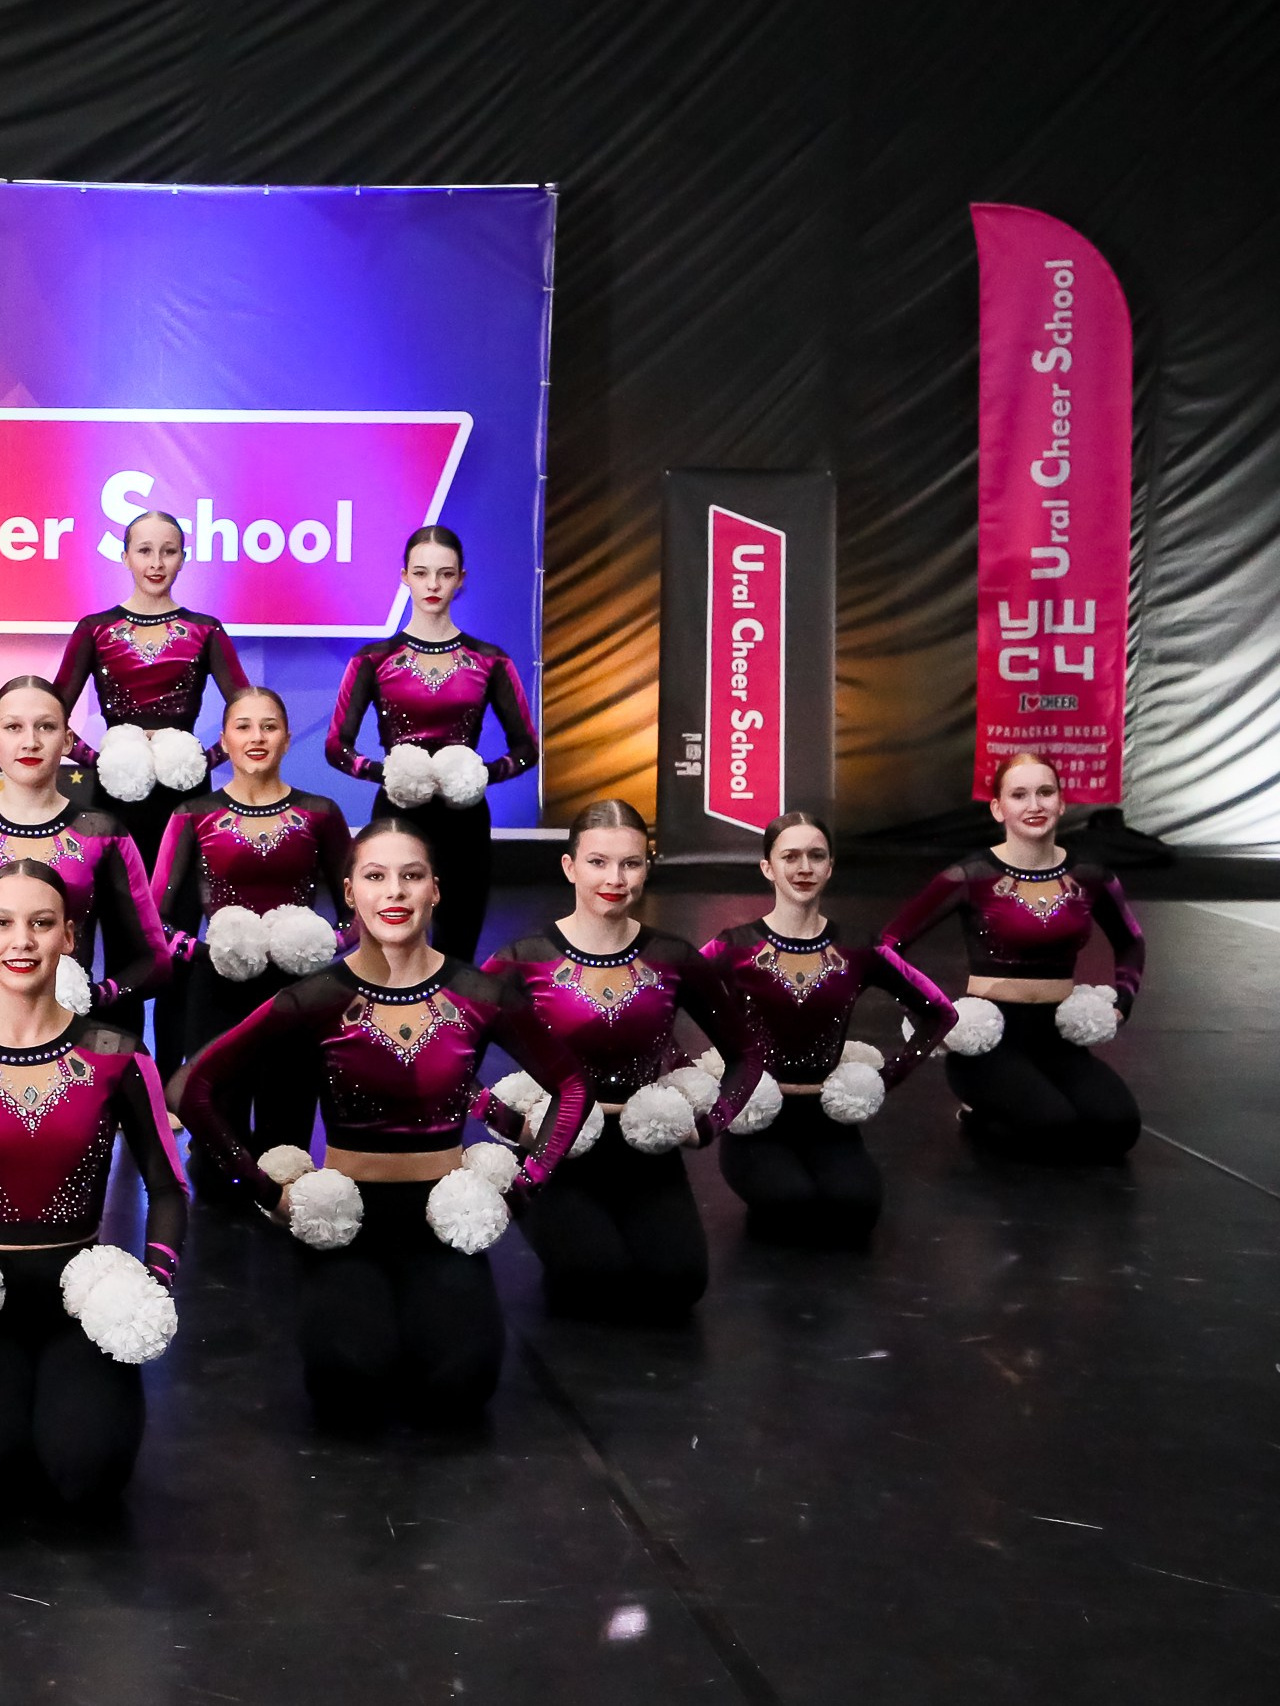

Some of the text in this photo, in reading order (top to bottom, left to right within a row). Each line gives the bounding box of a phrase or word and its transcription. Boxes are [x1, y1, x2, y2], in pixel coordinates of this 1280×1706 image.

[1031, 259, 1075, 580] Ural Cheer School
[730, 544, 765, 800] Ural Cheer School
